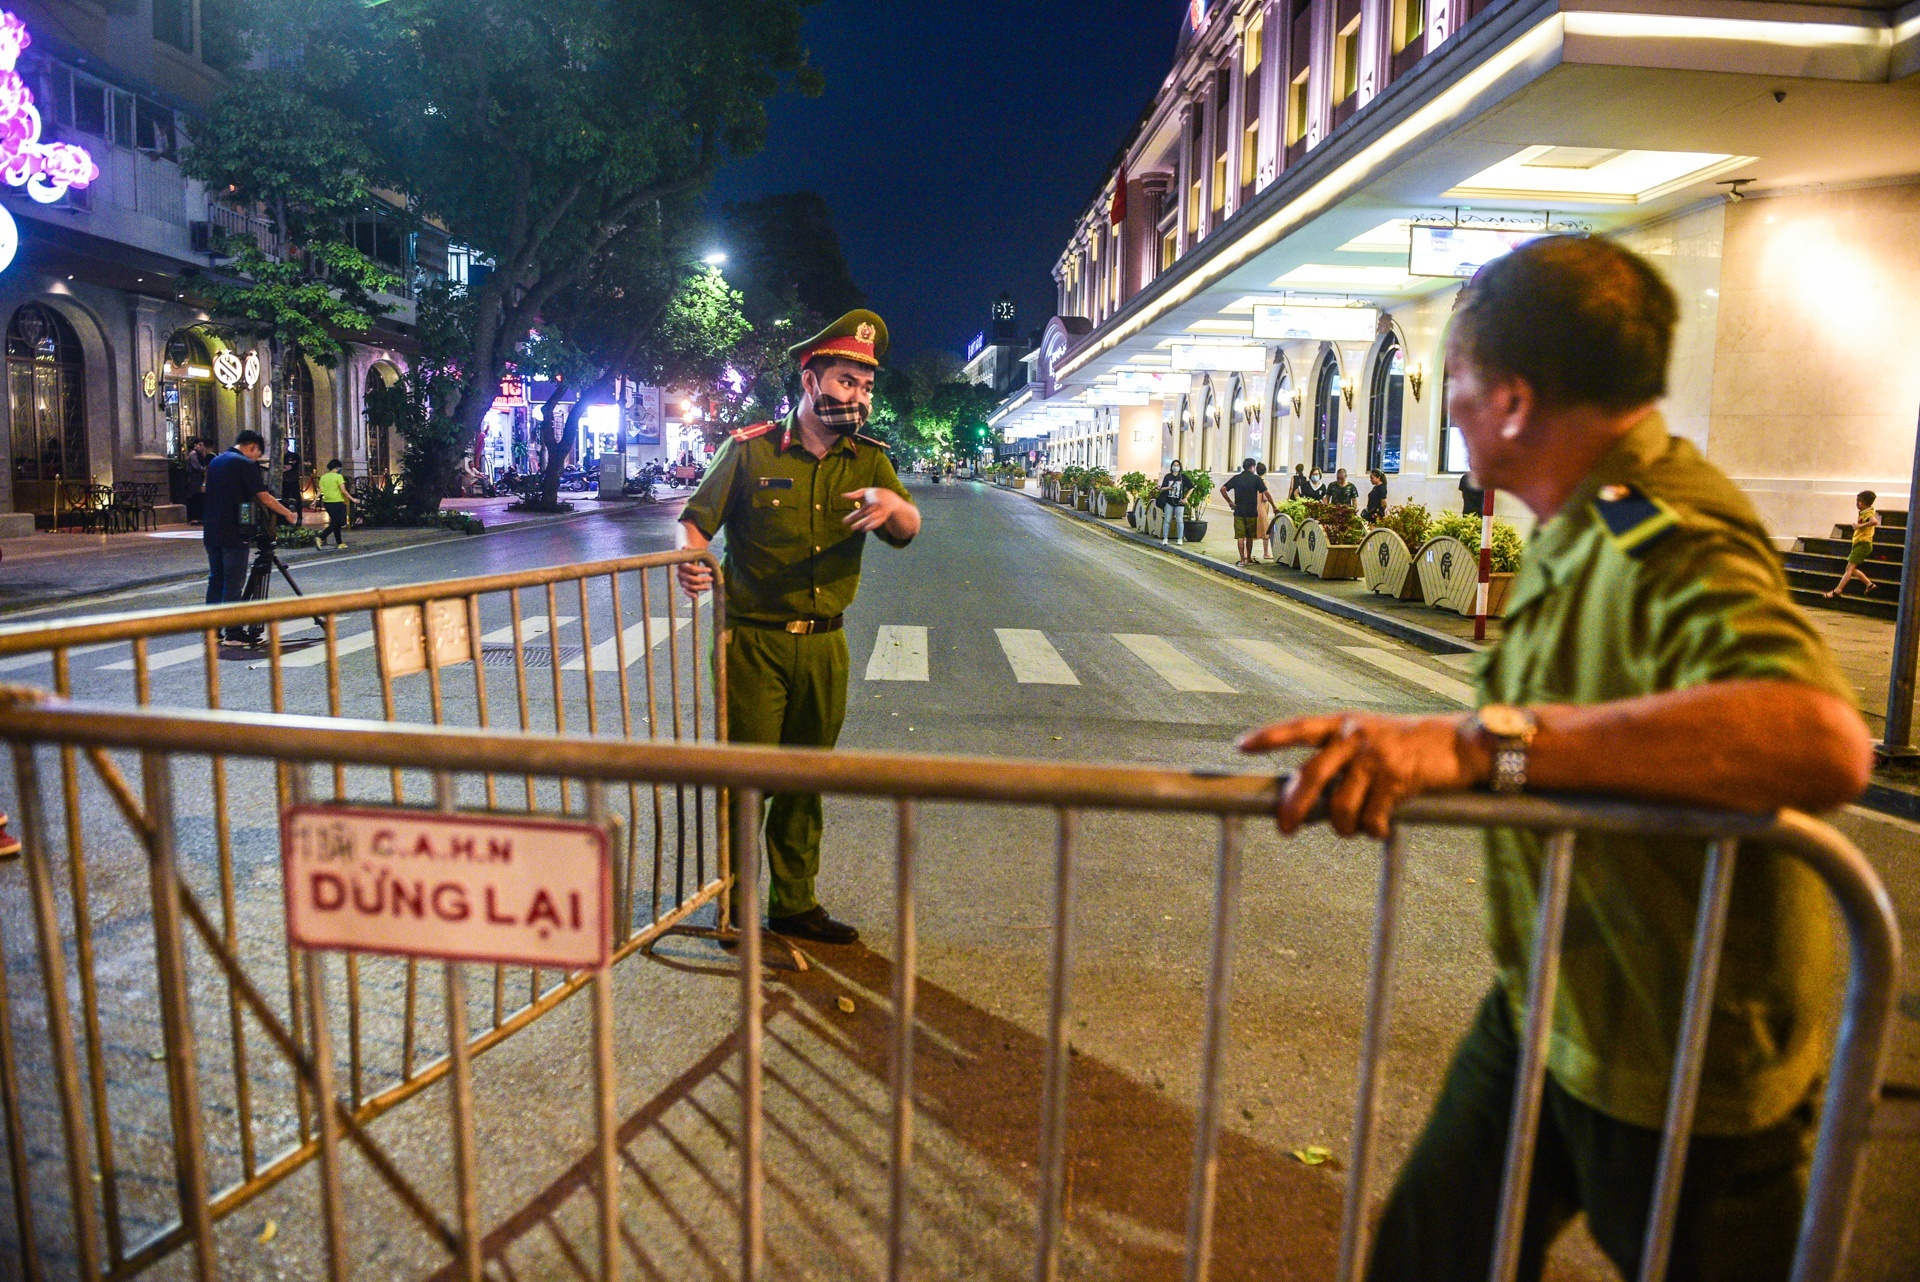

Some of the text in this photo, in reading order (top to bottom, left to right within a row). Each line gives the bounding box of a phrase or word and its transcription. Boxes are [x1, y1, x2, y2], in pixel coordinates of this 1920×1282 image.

[1133, 430, 1154, 442] Dor
[309, 863, 582, 939] DỪNG LẠI
